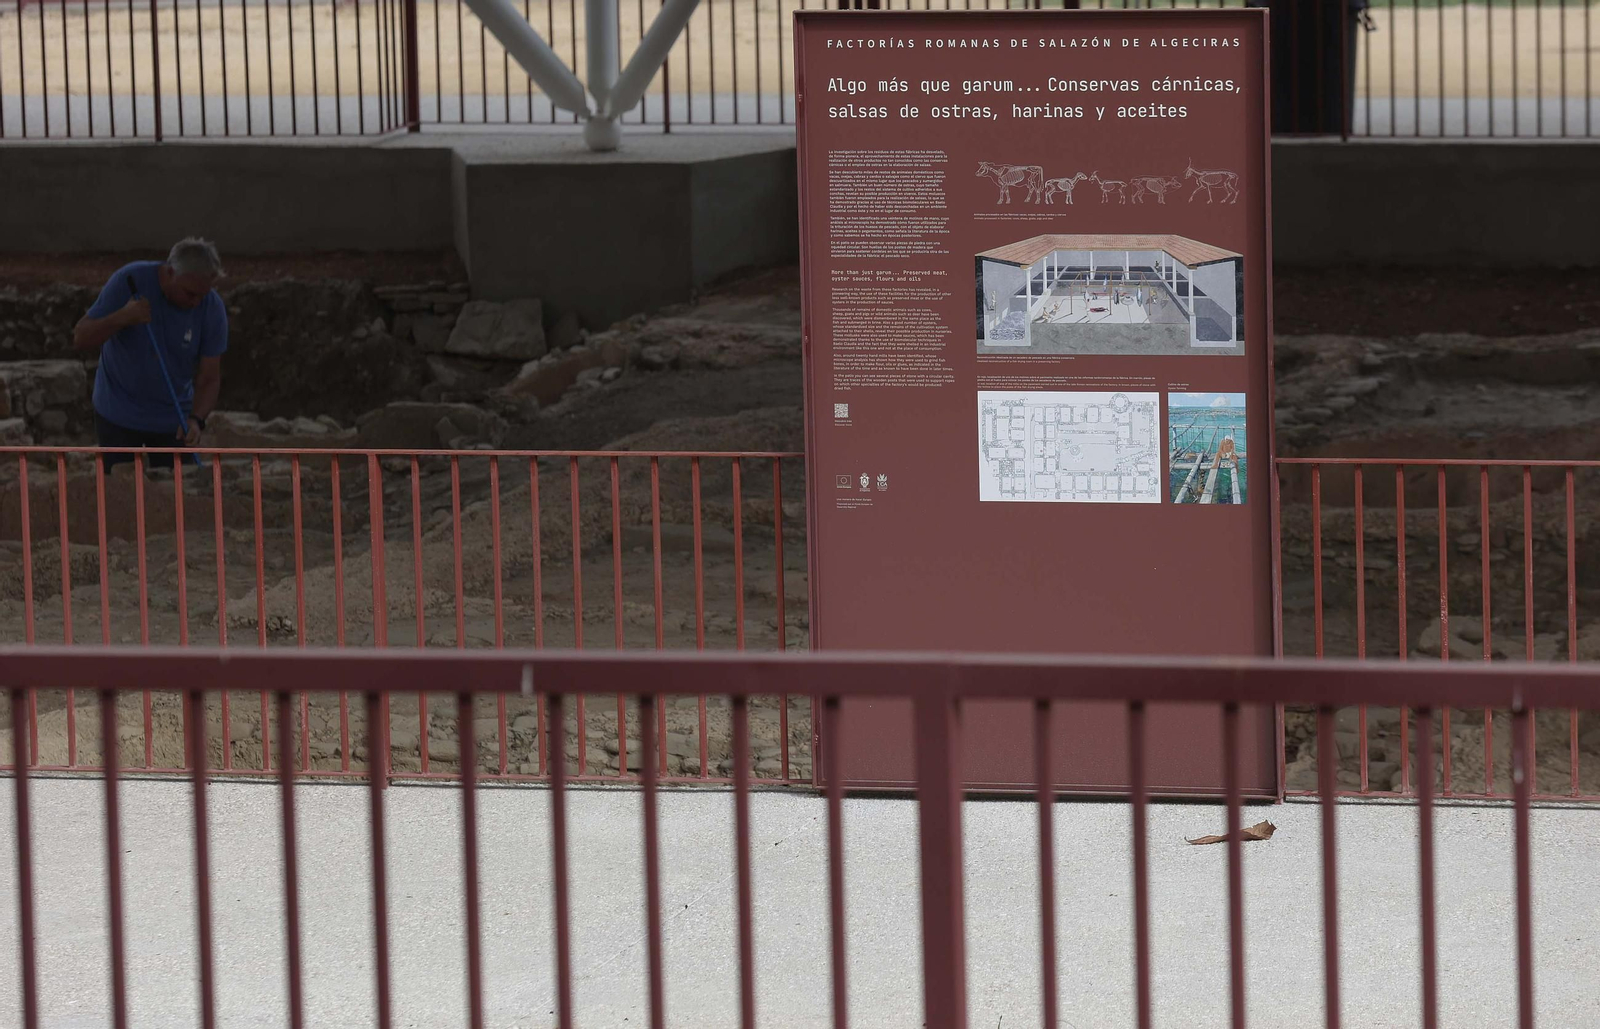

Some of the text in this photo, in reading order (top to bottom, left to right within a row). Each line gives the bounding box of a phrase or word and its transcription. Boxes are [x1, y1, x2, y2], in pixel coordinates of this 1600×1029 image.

[828, 37, 1239, 48] FACTORÍAS ROMANAS DE SALAZÓN DE ALGECIRAS
[828, 76, 1240, 94] Algo más que garum... Conservas cárnicas,
[829, 103, 1187, 120] salsas de ostras, harinas y aceites
